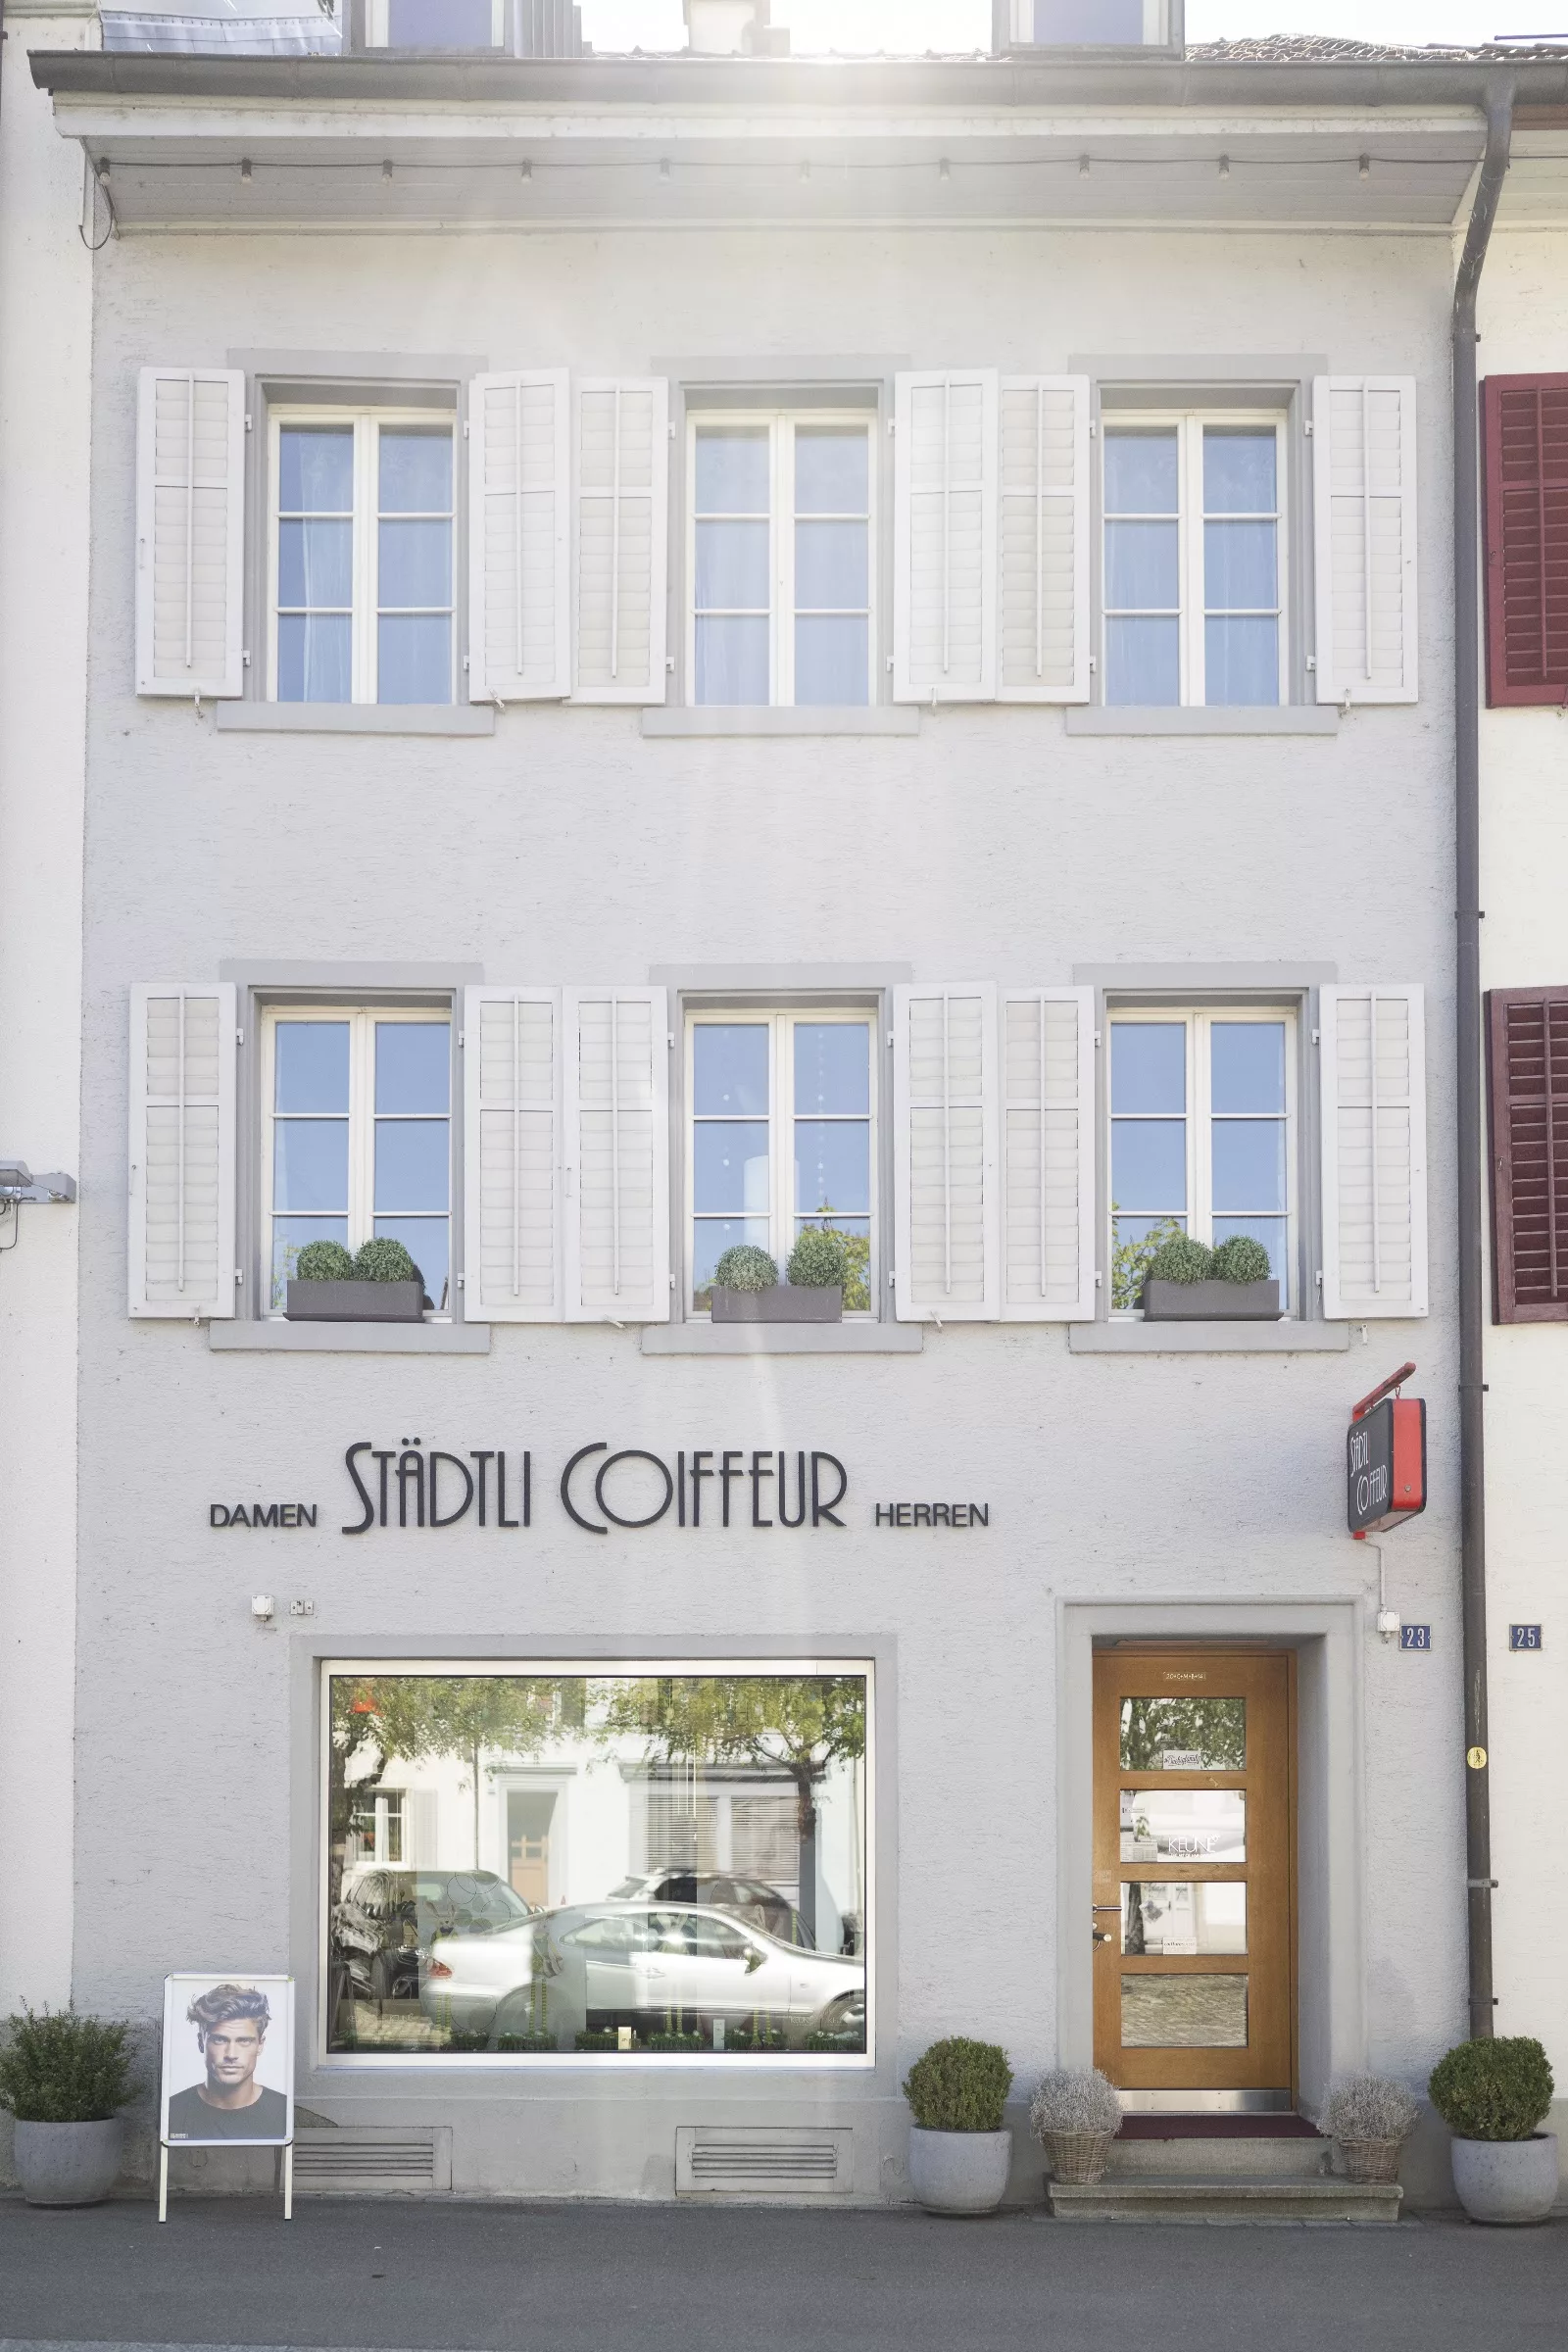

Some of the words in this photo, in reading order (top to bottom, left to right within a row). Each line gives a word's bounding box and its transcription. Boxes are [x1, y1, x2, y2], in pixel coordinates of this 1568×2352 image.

[210, 1504, 317, 1529] DAMEN
[342, 1438, 531, 1535] STÄDTLI
[560, 1442, 848, 1535] COIFFEUR
[875, 1502, 989, 1529] HERREN
[1406, 1628, 1425, 1647] 23
[1516, 1628, 1536, 1647] 25
[1168, 1837, 1216, 1852] KEUNE
